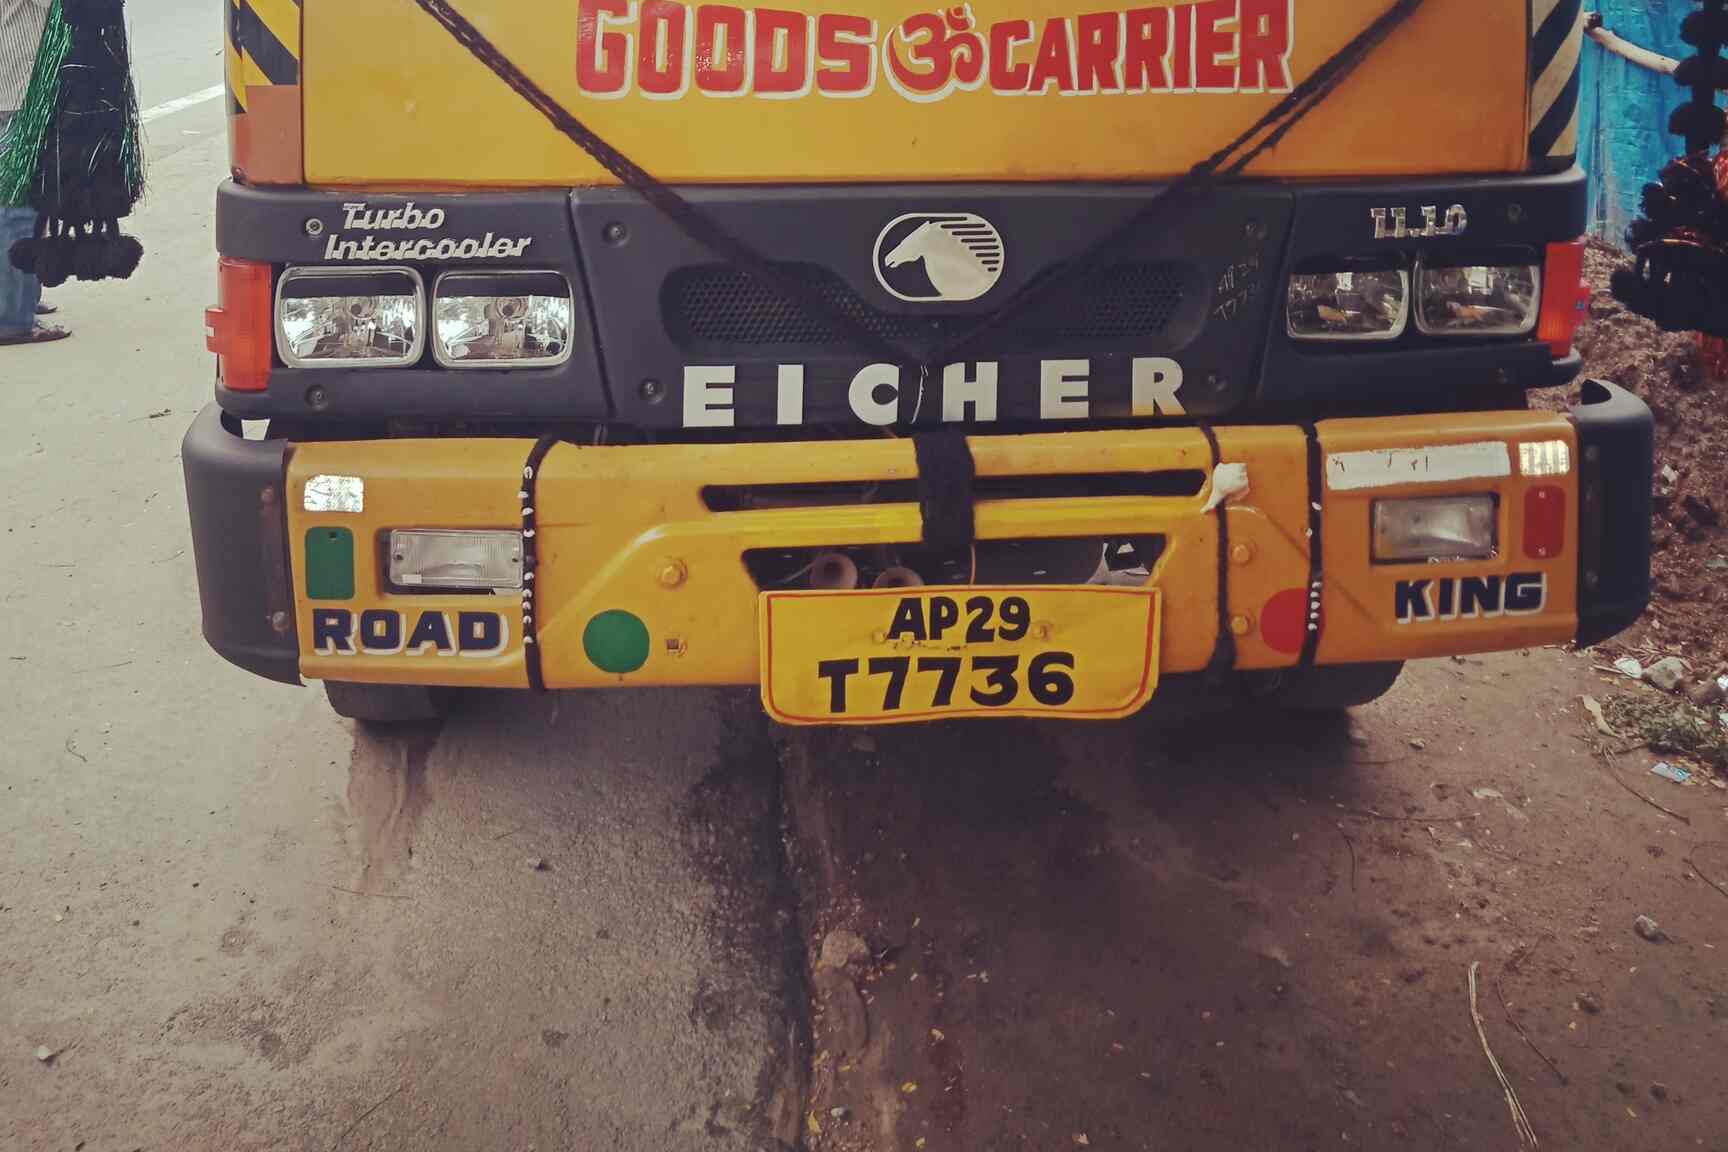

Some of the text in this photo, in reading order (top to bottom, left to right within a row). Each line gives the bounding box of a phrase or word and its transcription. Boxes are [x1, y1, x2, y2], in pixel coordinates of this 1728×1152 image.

[342, 201, 445, 230] Turbo
[324, 232, 532, 260] Intercooler
[682, 356, 1187, 428] EICHER
[312, 571, 1548, 658] ROAD KING
[886, 595, 1031, 644] AP29
[817, 651, 1075, 714] T7736
